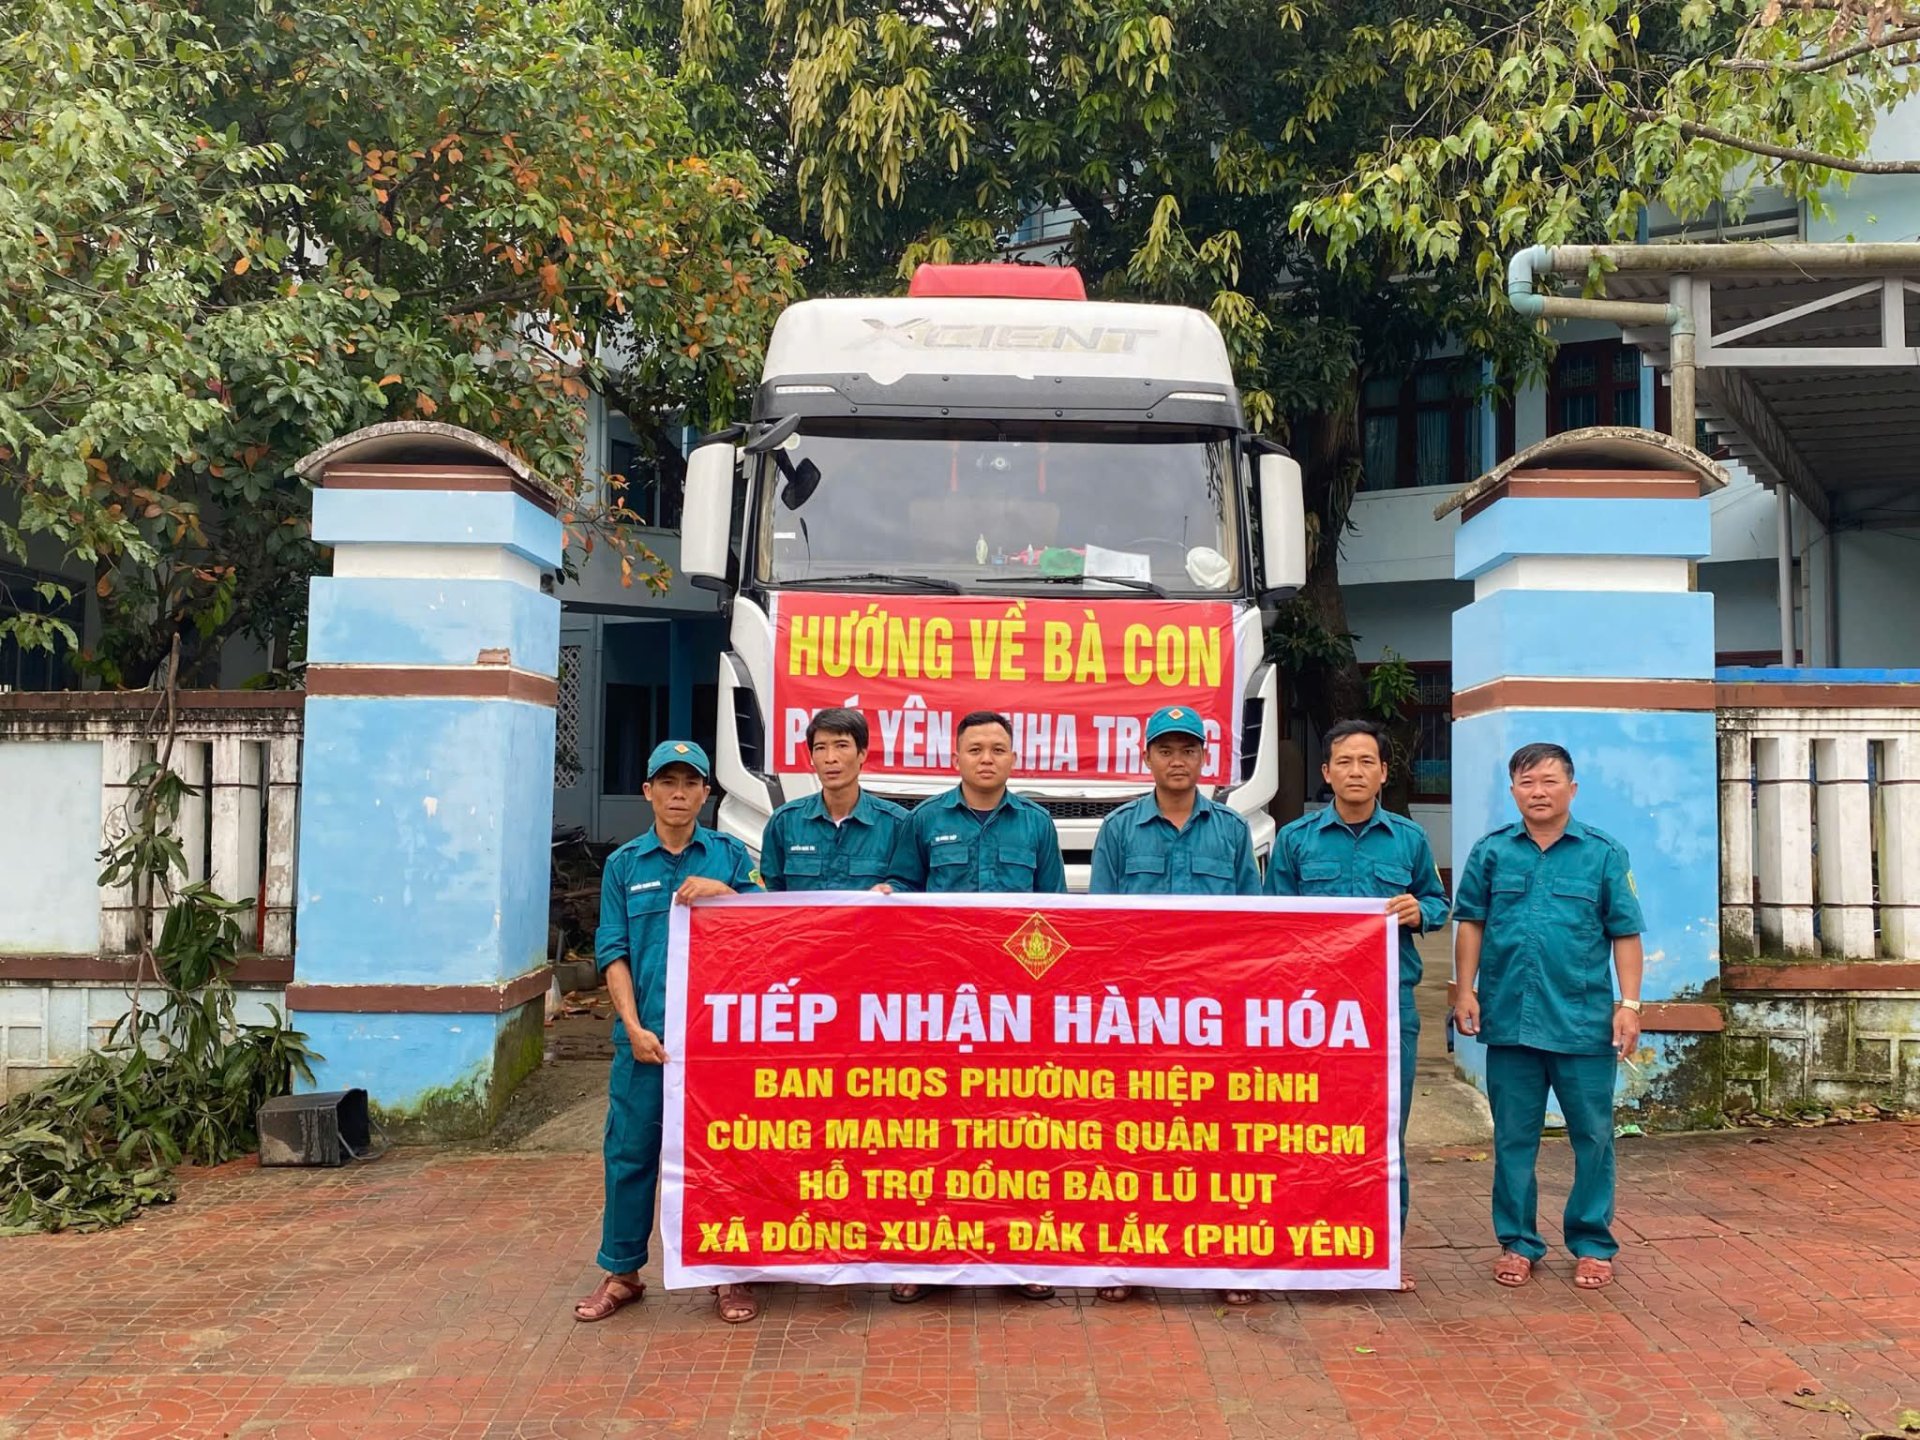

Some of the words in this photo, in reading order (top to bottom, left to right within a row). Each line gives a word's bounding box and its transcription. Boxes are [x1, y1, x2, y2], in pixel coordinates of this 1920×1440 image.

[842, 317, 1159, 354] XCIENT
[788, 602, 954, 680] HƯỚNG
[969, 599, 1027, 681] VỀ
[1043, 608, 1107, 684] BÀ
[1123, 622, 1222, 688] CON
[877, 693, 953, 769] YÊN
[1093, 714, 1221, 778] TRG
[704, 976, 838, 1043] TIẾP
[859, 983, 1032, 1053] NHẬN
[1054, 985, 1223, 1046] HÀNG
[1245, 988, 1371, 1049] HÓA
[754, 1067, 833, 1098] BAN
[846, 1066, 948, 1101] CHQS
[960, 1061, 1115, 1100] PHƯỜNG
[1128, 1064, 1215, 1107] HIỆP
[1228, 1066, 1319, 1103] BÌNH
[707, 1113, 812, 1151] CÙNG
[825, 1118, 940, 1156] MẠNH
[951, 1112, 1103, 1151] THƯỜNG
[1115, 1116, 1220, 1154] QUÂN
[1231, 1123, 1366, 1155] TPHCM
[799, 1159, 849, 1200] HỖ
[861, 1166, 935, 1206] TRỢ
[944, 1159, 1050, 1201] ĐỒNG
[1063, 1165, 1139, 1202] BÀO
[1152, 1166, 1197, 1203] LŨ
[1210, 1172, 1277, 1209] LỤT
[698, 1216, 750, 1253] XÃ
[761, 1212, 867, 1253] ĐỒNG
[879, 1214, 996, 1255] XUÂN,
[1007, 1210, 1085, 1252] ĐẮK
[1098, 1212, 1170, 1254] LẮK
[1183, 1219, 1275, 1258] (PHÚ
[1286, 1219, 1375, 1259] YÊN)
